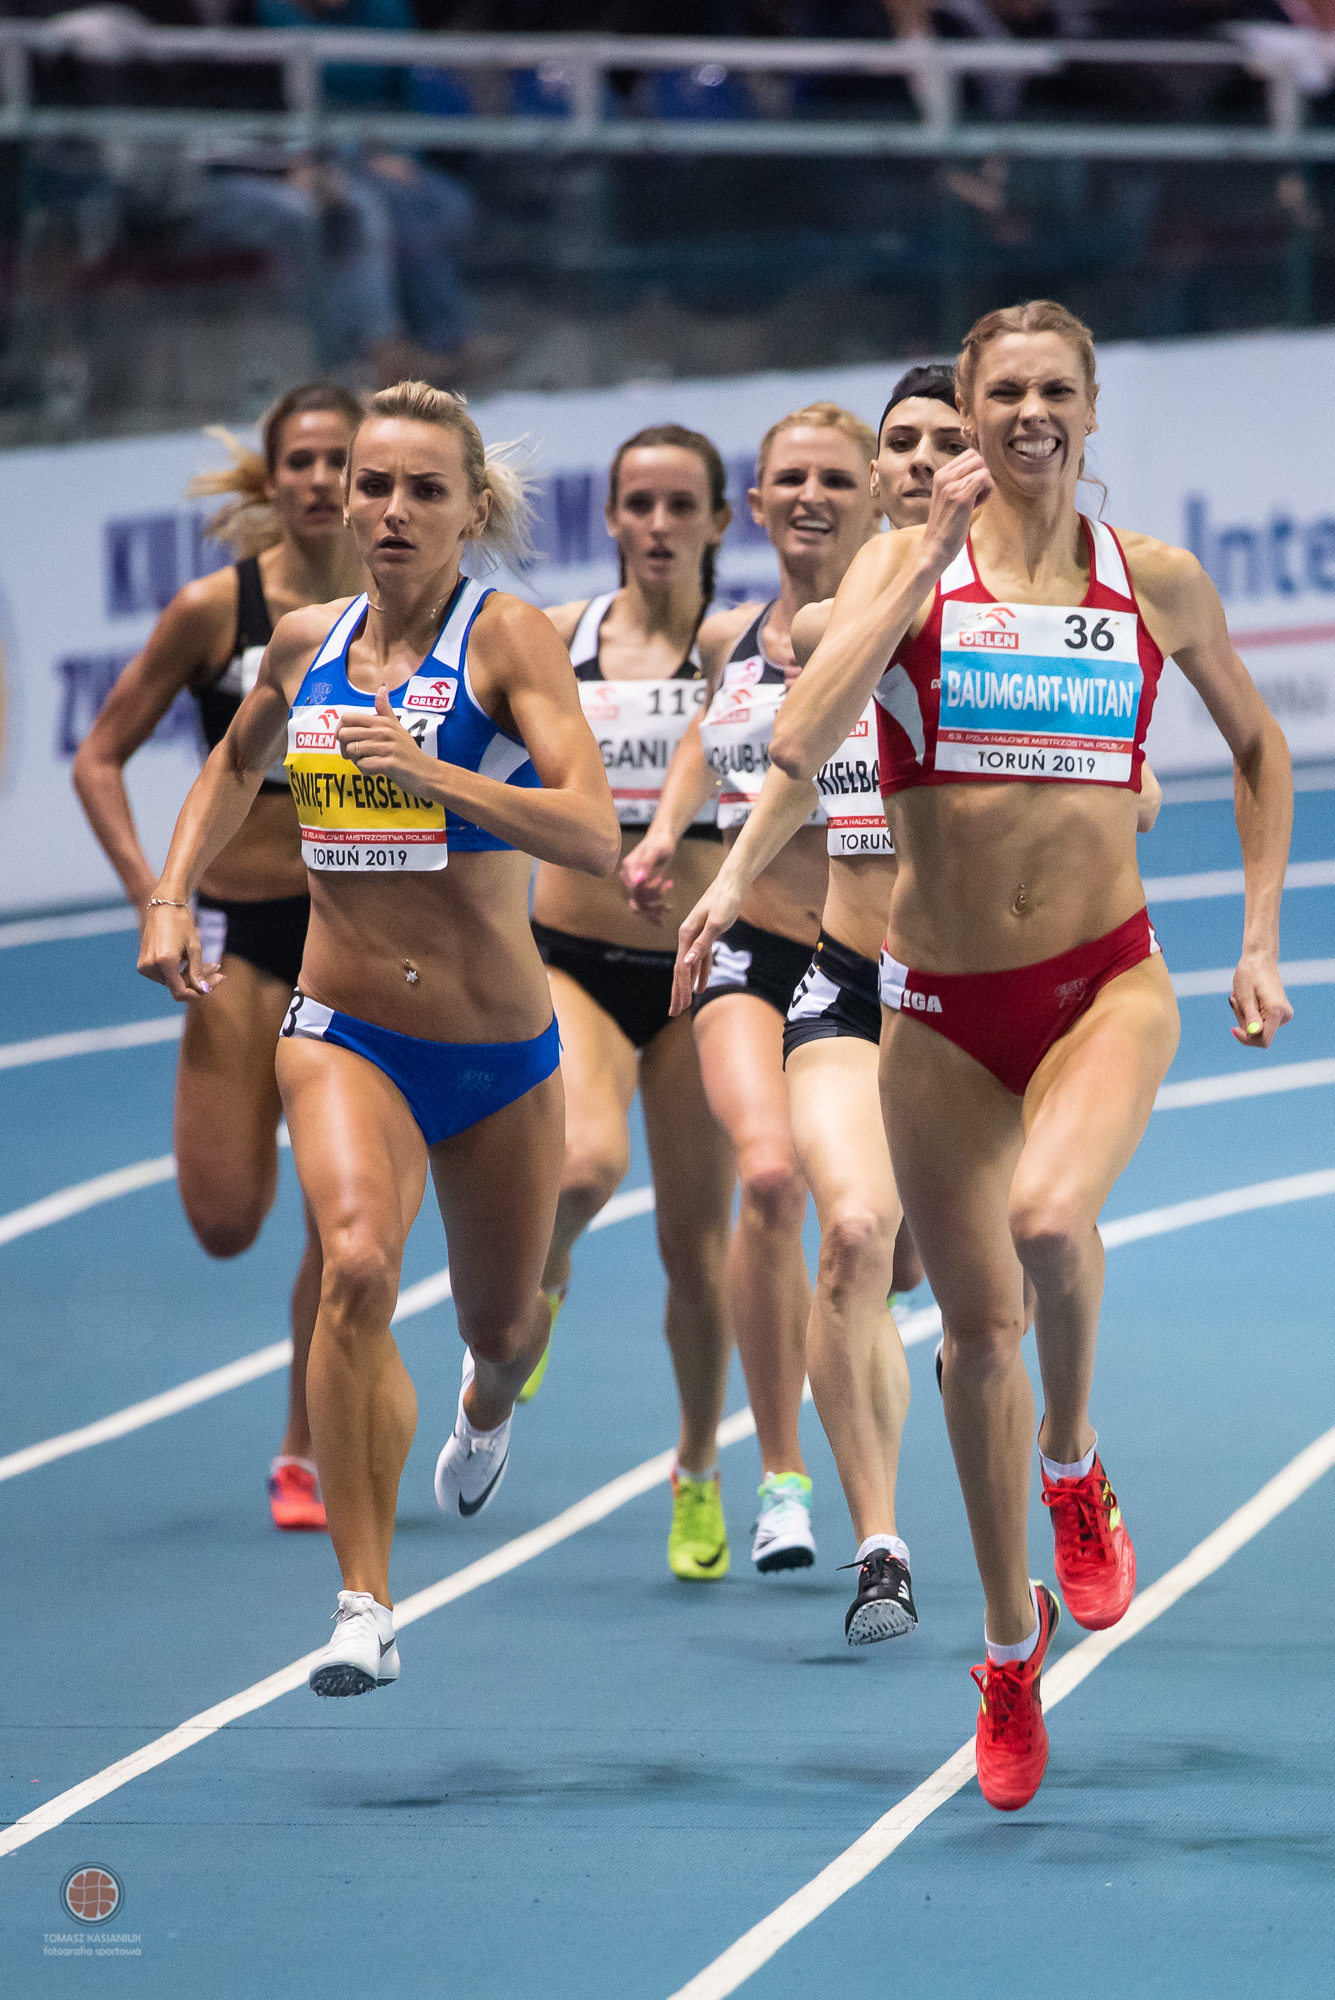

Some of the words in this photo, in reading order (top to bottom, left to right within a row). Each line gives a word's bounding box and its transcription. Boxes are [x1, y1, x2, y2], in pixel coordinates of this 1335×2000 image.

[961, 632, 1016, 648] ORLEN
[1064, 614, 1115, 651] 36
[411, 697, 447, 708] ORLEN
[946, 669, 1134, 718] BAUMGART-WITAN
[297, 733, 335, 748] ORLEN
[965, 734, 989, 742] PZLA
[991, 735, 1029, 744] HALOWE
[1031, 737, 1094, 748] MISTRZOSTWA
[977, 749, 1045, 770] TORUŃ
[1052, 755, 1096, 773] 2019
[290, 764, 434, 815] ŚWIĘTY-ERSE
[849, 818, 880, 826] HALOWE
[345, 833, 403, 841] MISTRZOSTWA
[841, 829, 894, 850] TORUŃ
[313, 845, 359, 866] TORUŃ
[365, 850, 408, 866] 2019
